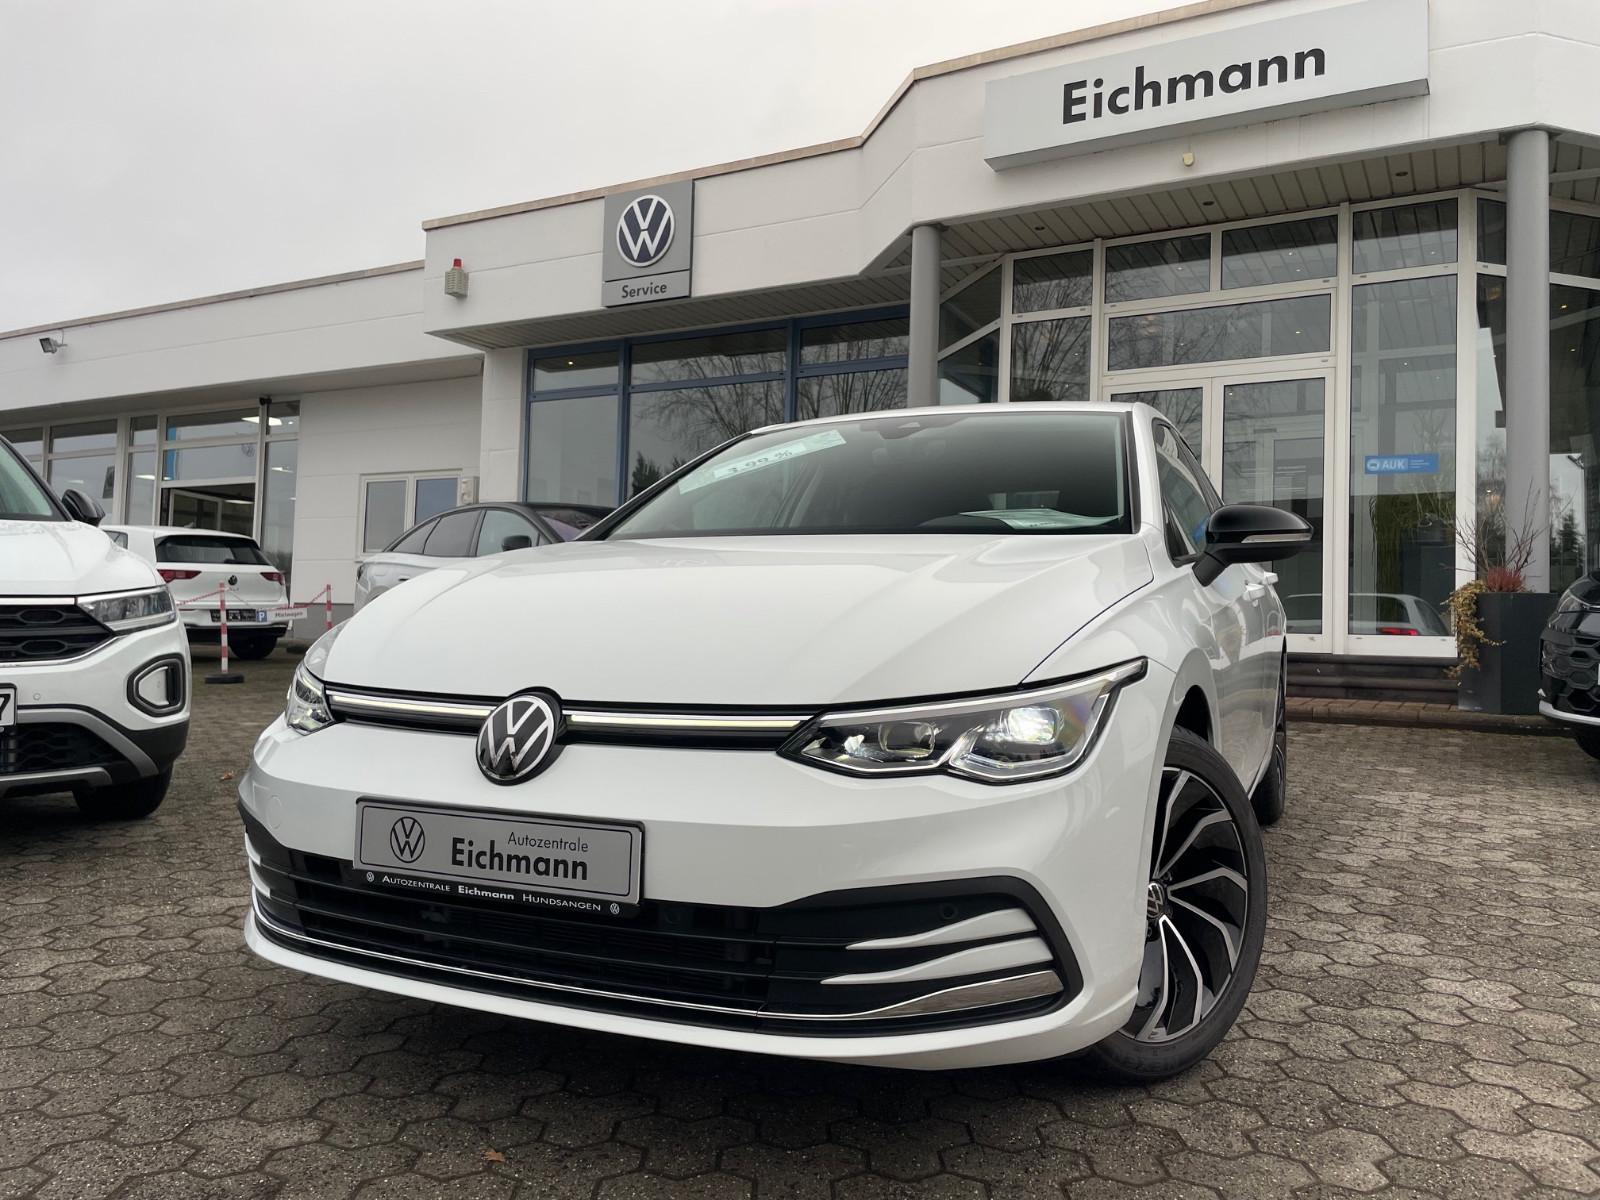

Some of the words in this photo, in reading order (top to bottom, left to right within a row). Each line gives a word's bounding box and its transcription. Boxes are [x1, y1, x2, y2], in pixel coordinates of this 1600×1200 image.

[1062, 47, 1326, 125] Eichmann
[621, 282, 667, 299] Service
[1381, 459, 1406, 470] AUK
[507, 831, 589, 853] Autozentrale
[451, 836, 588, 881] Eichmann
[382, 875, 451, 892] AUTOZENTRALE
[458, 885, 515, 901] Eichmann
[522, 893, 601, 912] HUNDSANGEN
